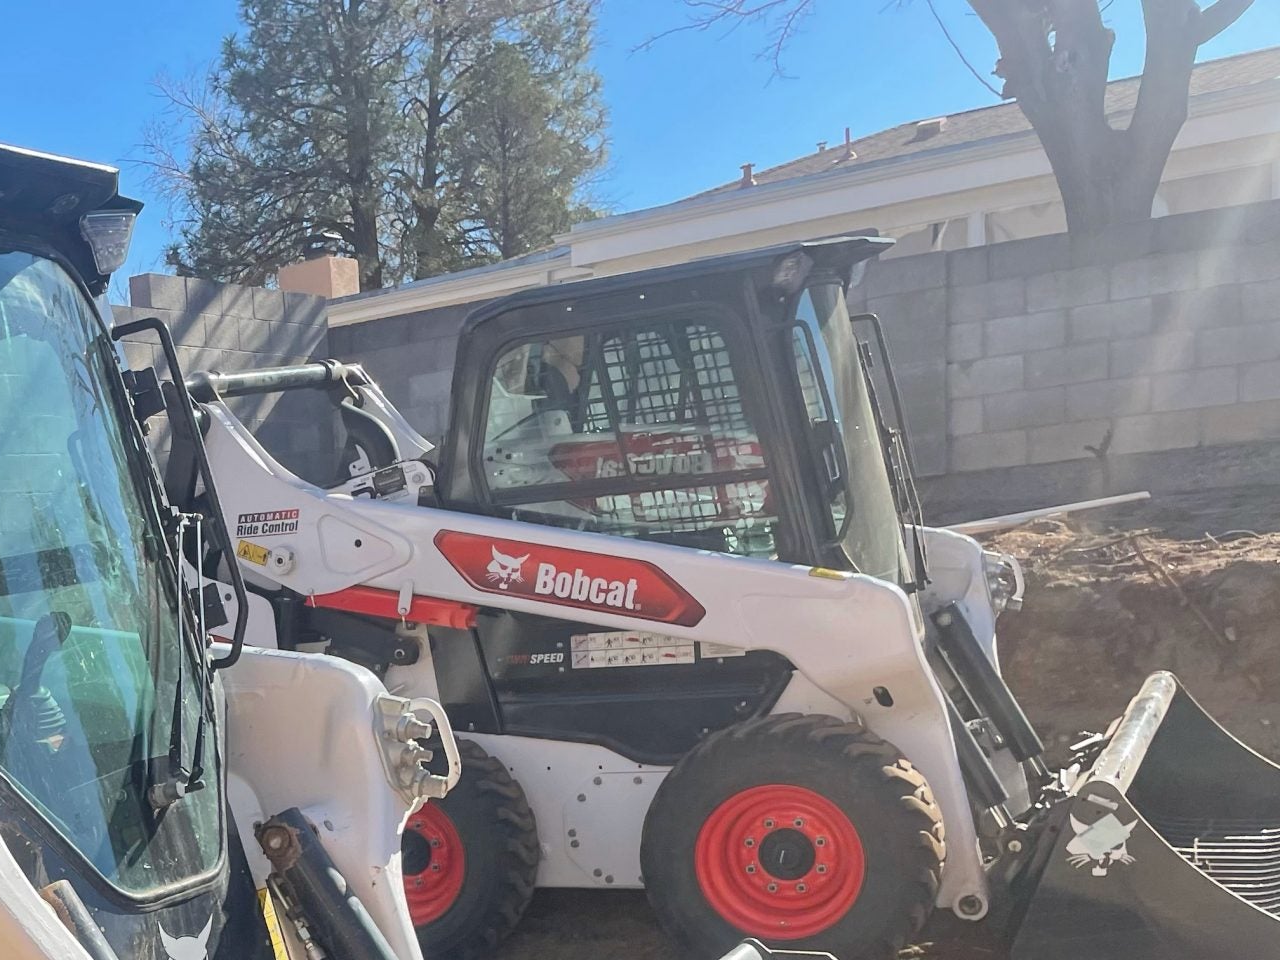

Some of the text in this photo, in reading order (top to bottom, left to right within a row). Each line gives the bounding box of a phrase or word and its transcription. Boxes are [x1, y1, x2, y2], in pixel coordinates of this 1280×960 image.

[240, 510, 298, 523] AUTOMATIC
[236, 520, 299, 536] Ride Control
[535, 562, 638, 610] Bobcat
[529, 652, 564, 664] SPEED
